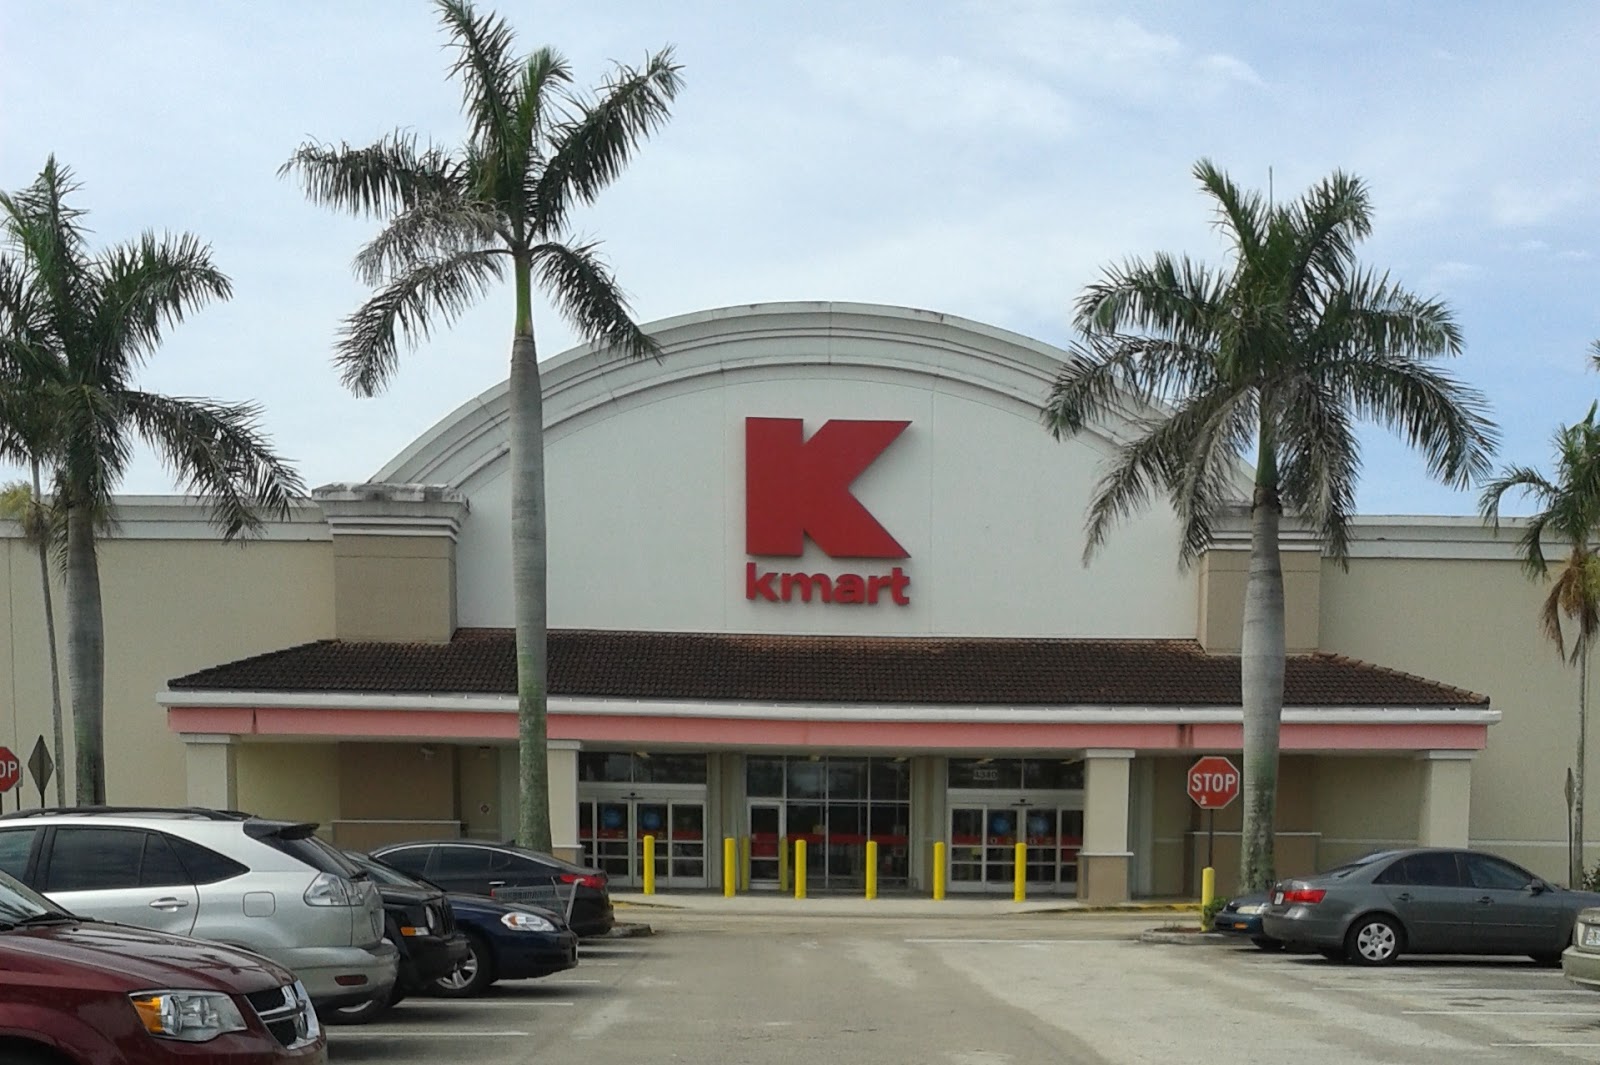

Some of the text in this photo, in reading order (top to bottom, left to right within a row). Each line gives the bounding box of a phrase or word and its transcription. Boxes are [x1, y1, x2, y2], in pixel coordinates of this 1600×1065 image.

[745, 417, 913, 558] K
[746, 562, 910, 606] kmart
[1191, 773, 1236, 793] STOP
